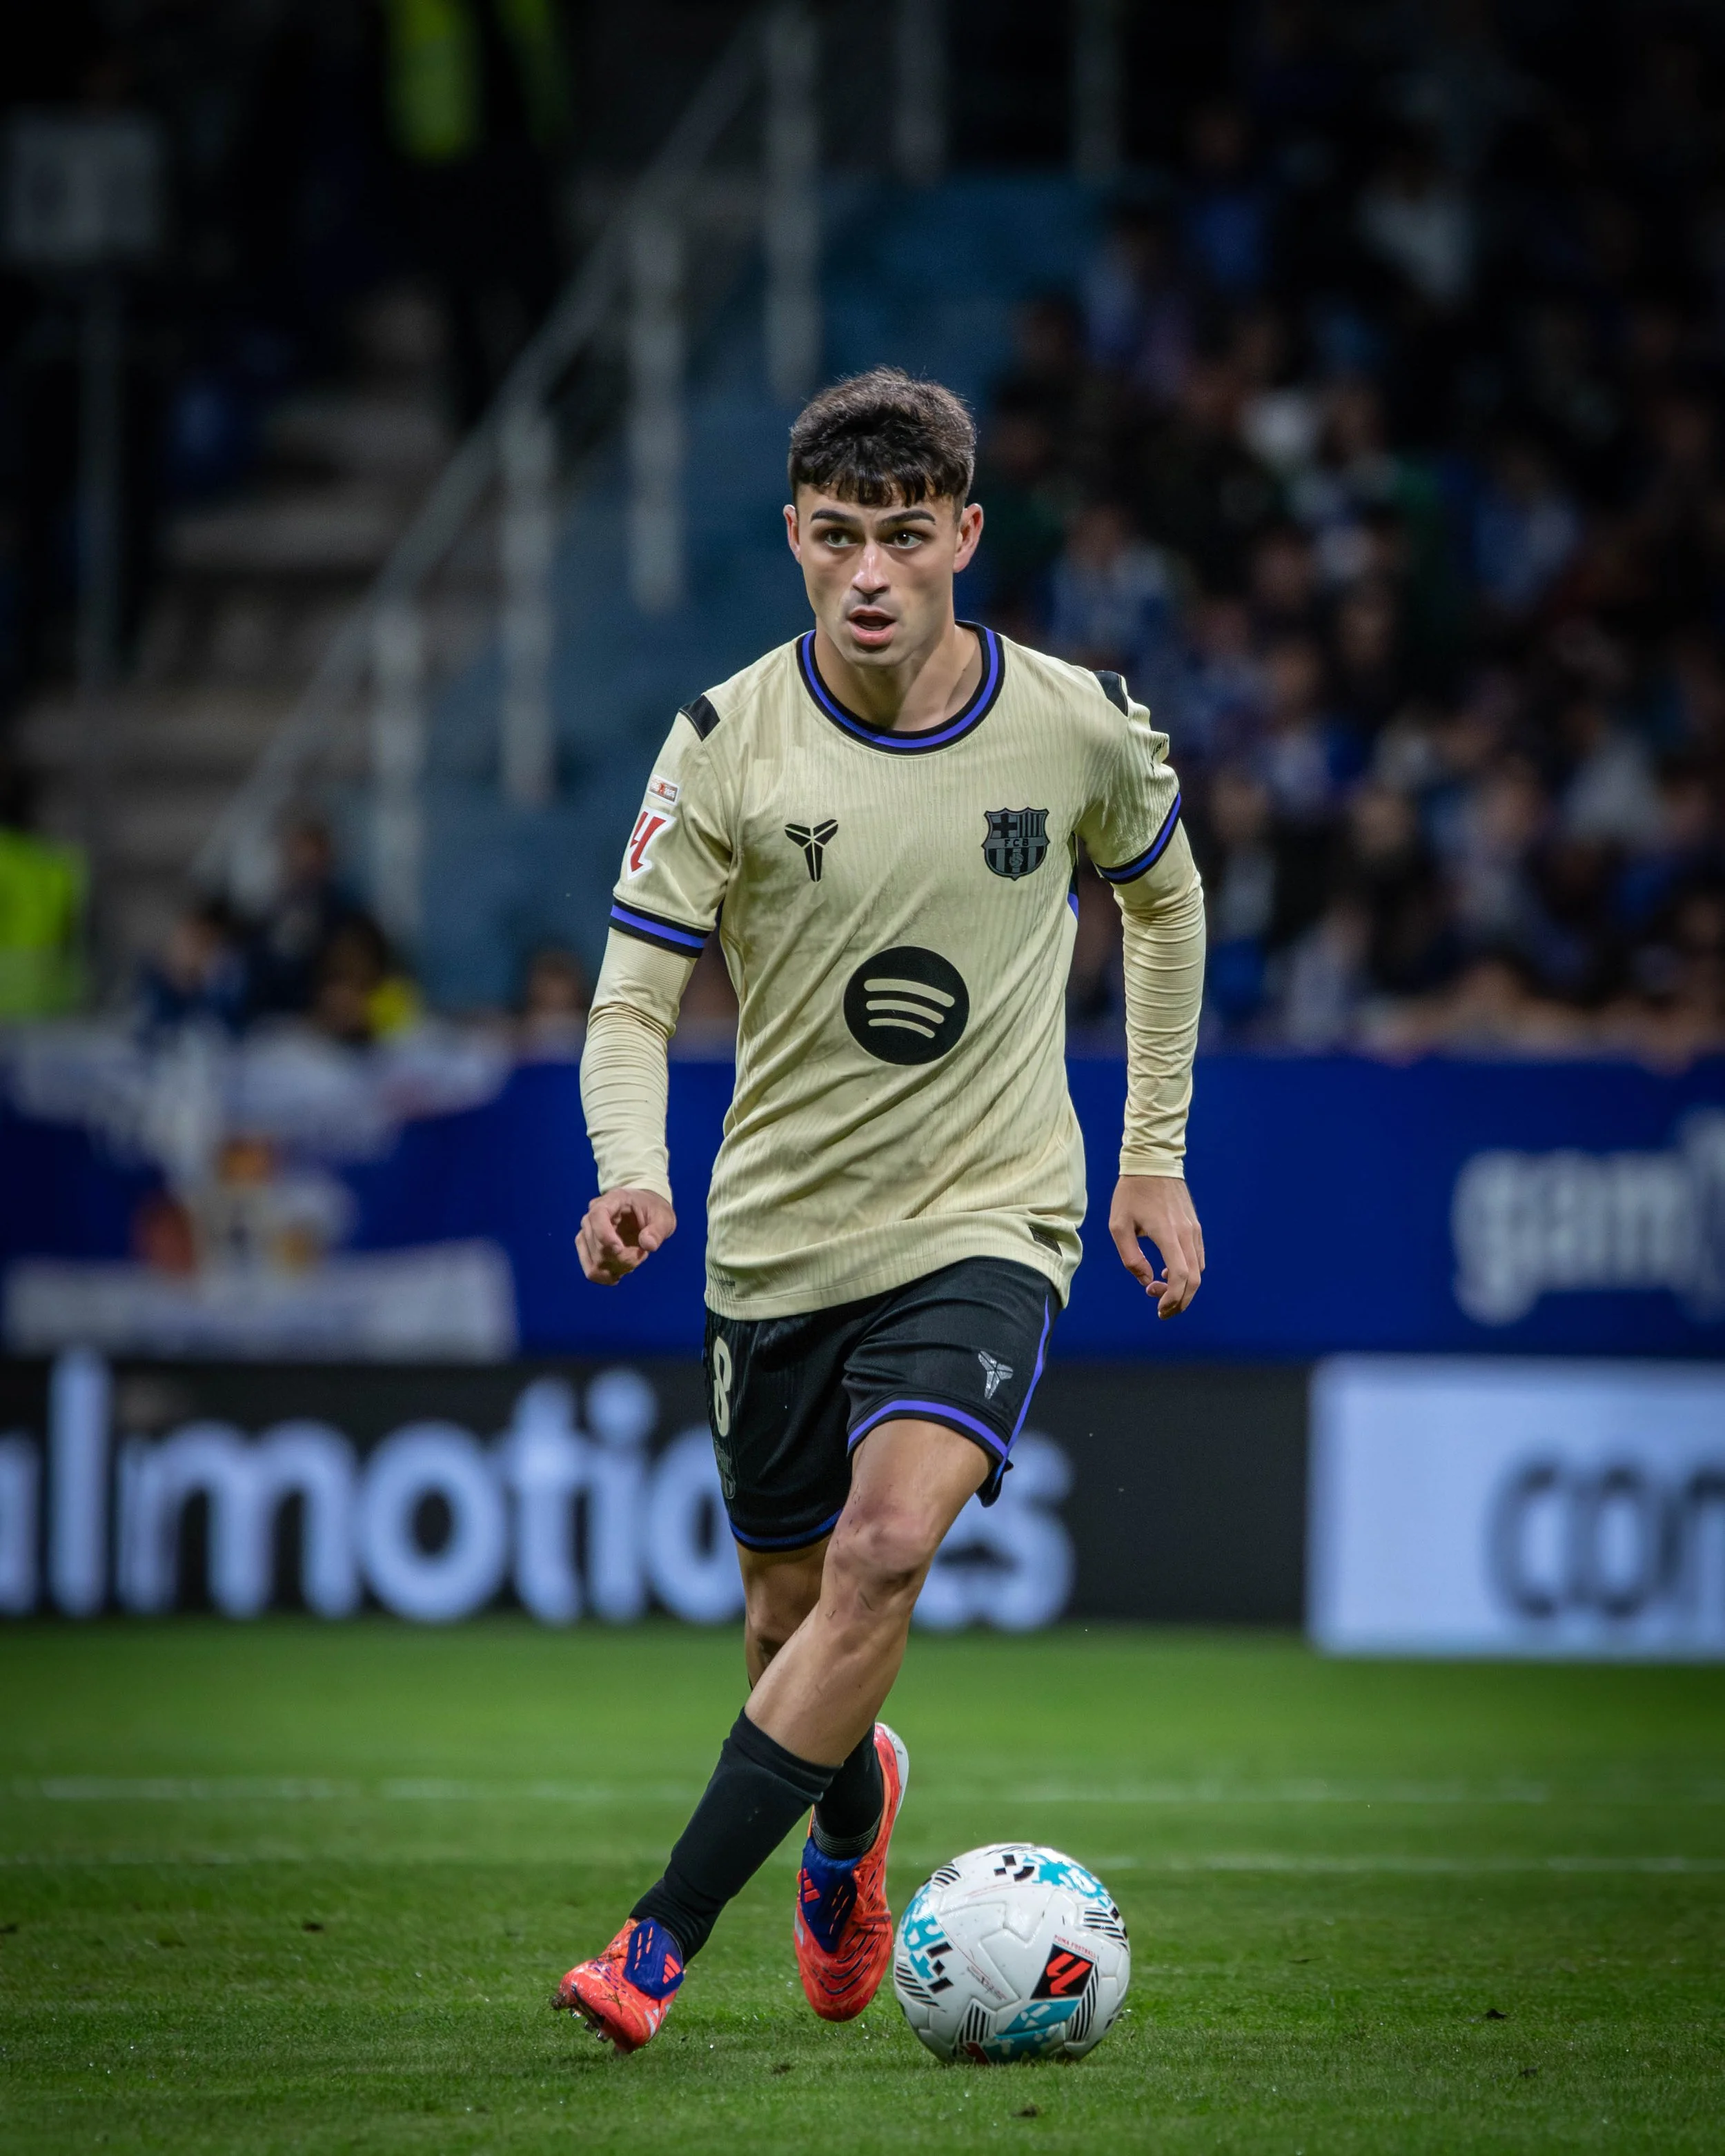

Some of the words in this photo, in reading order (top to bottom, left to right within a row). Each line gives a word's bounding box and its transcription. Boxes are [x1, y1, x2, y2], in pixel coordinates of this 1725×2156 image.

[1005, 838, 1029, 847] FCB
[713, 1336, 732, 1437] 8
[1054, 1934, 1070, 1945] PUMA
[1071, 1941, 1096, 1959] FOOTBALL
